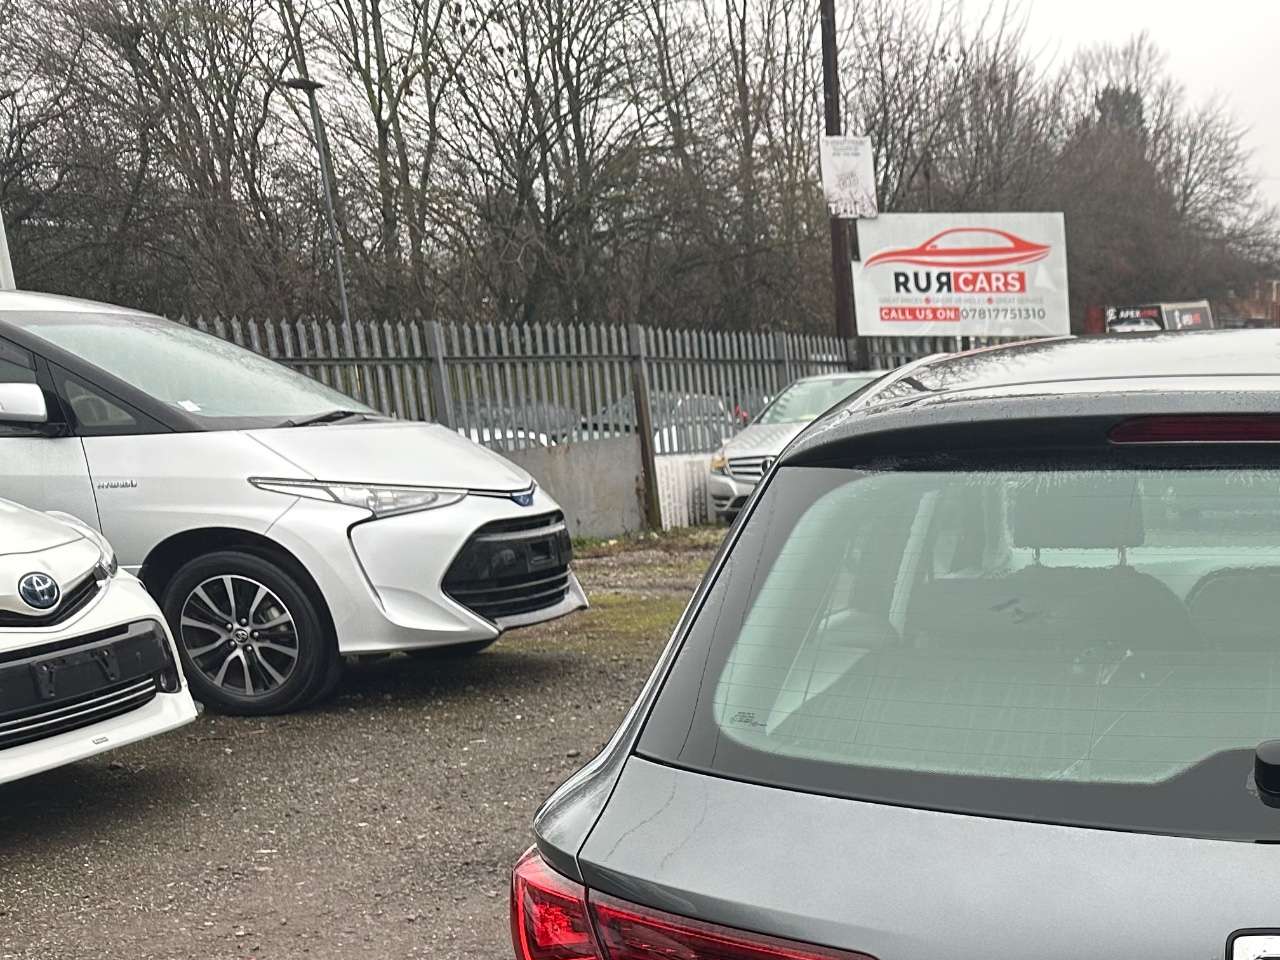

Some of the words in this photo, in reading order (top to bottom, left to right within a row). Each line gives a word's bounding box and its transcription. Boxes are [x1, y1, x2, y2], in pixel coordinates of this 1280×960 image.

[957, 272, 1021, 293] CARS
[881, 308, 913, 320] CALL
[915, 308, 933, 320] US
[936, 308, 956, 320] ON
[960, 308, 1046, 320] 07817751310
